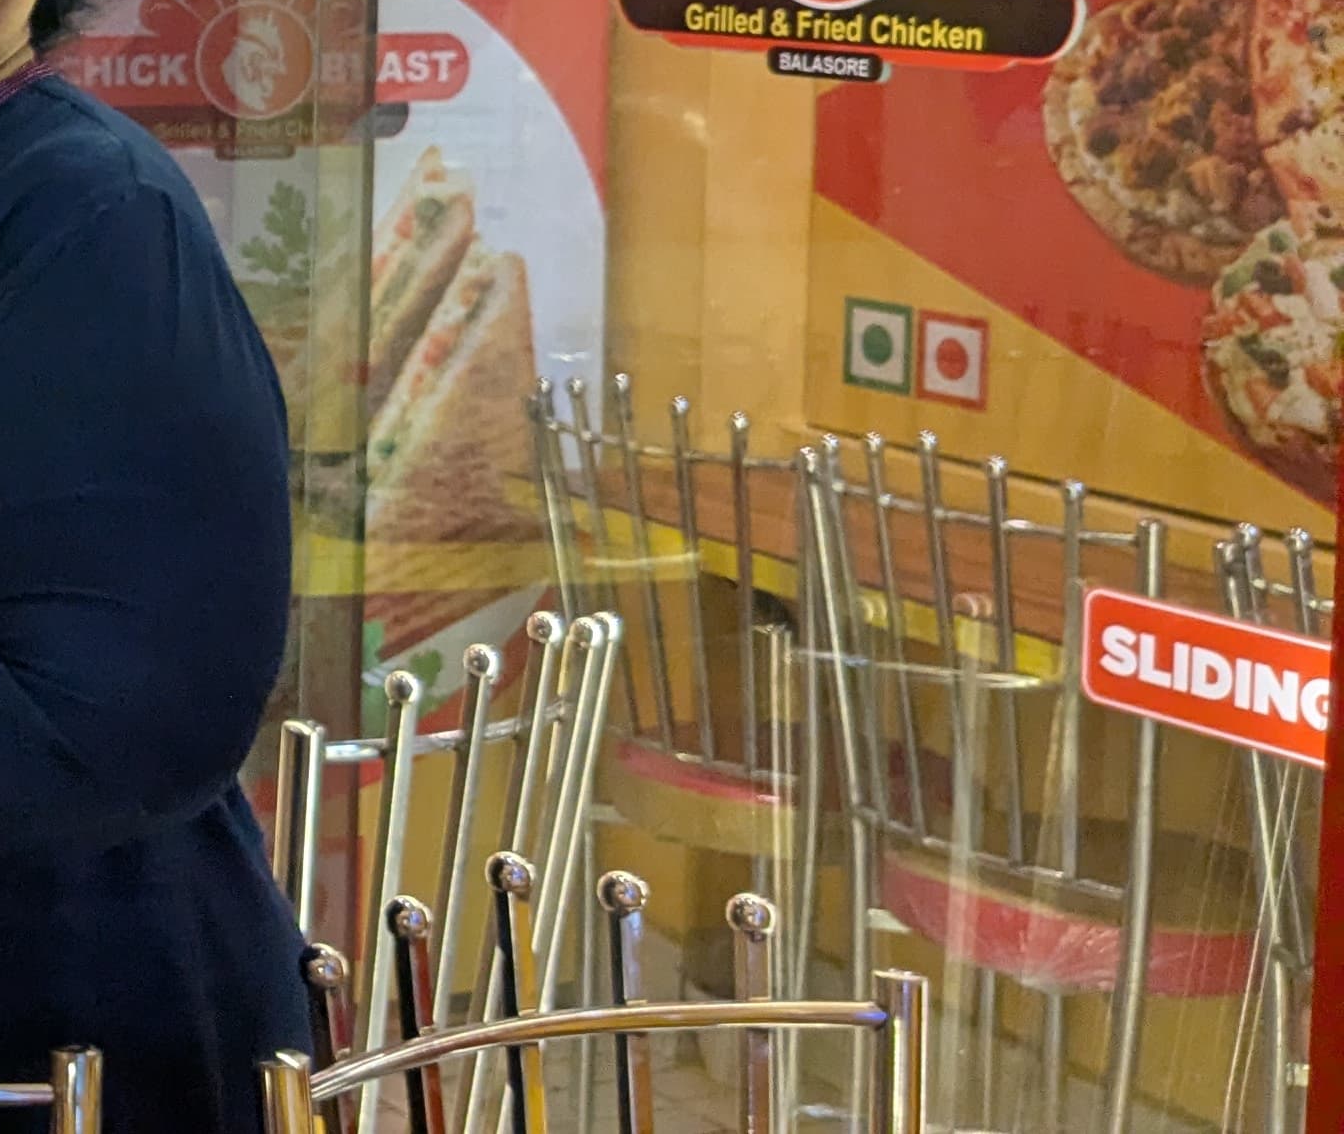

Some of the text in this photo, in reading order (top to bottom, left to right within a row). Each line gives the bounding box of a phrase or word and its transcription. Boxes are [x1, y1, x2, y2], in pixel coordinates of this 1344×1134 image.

[685, 2, 984, 51] Grilled & Fried Chicken
[778, 52, 869, 77] BALASORE
